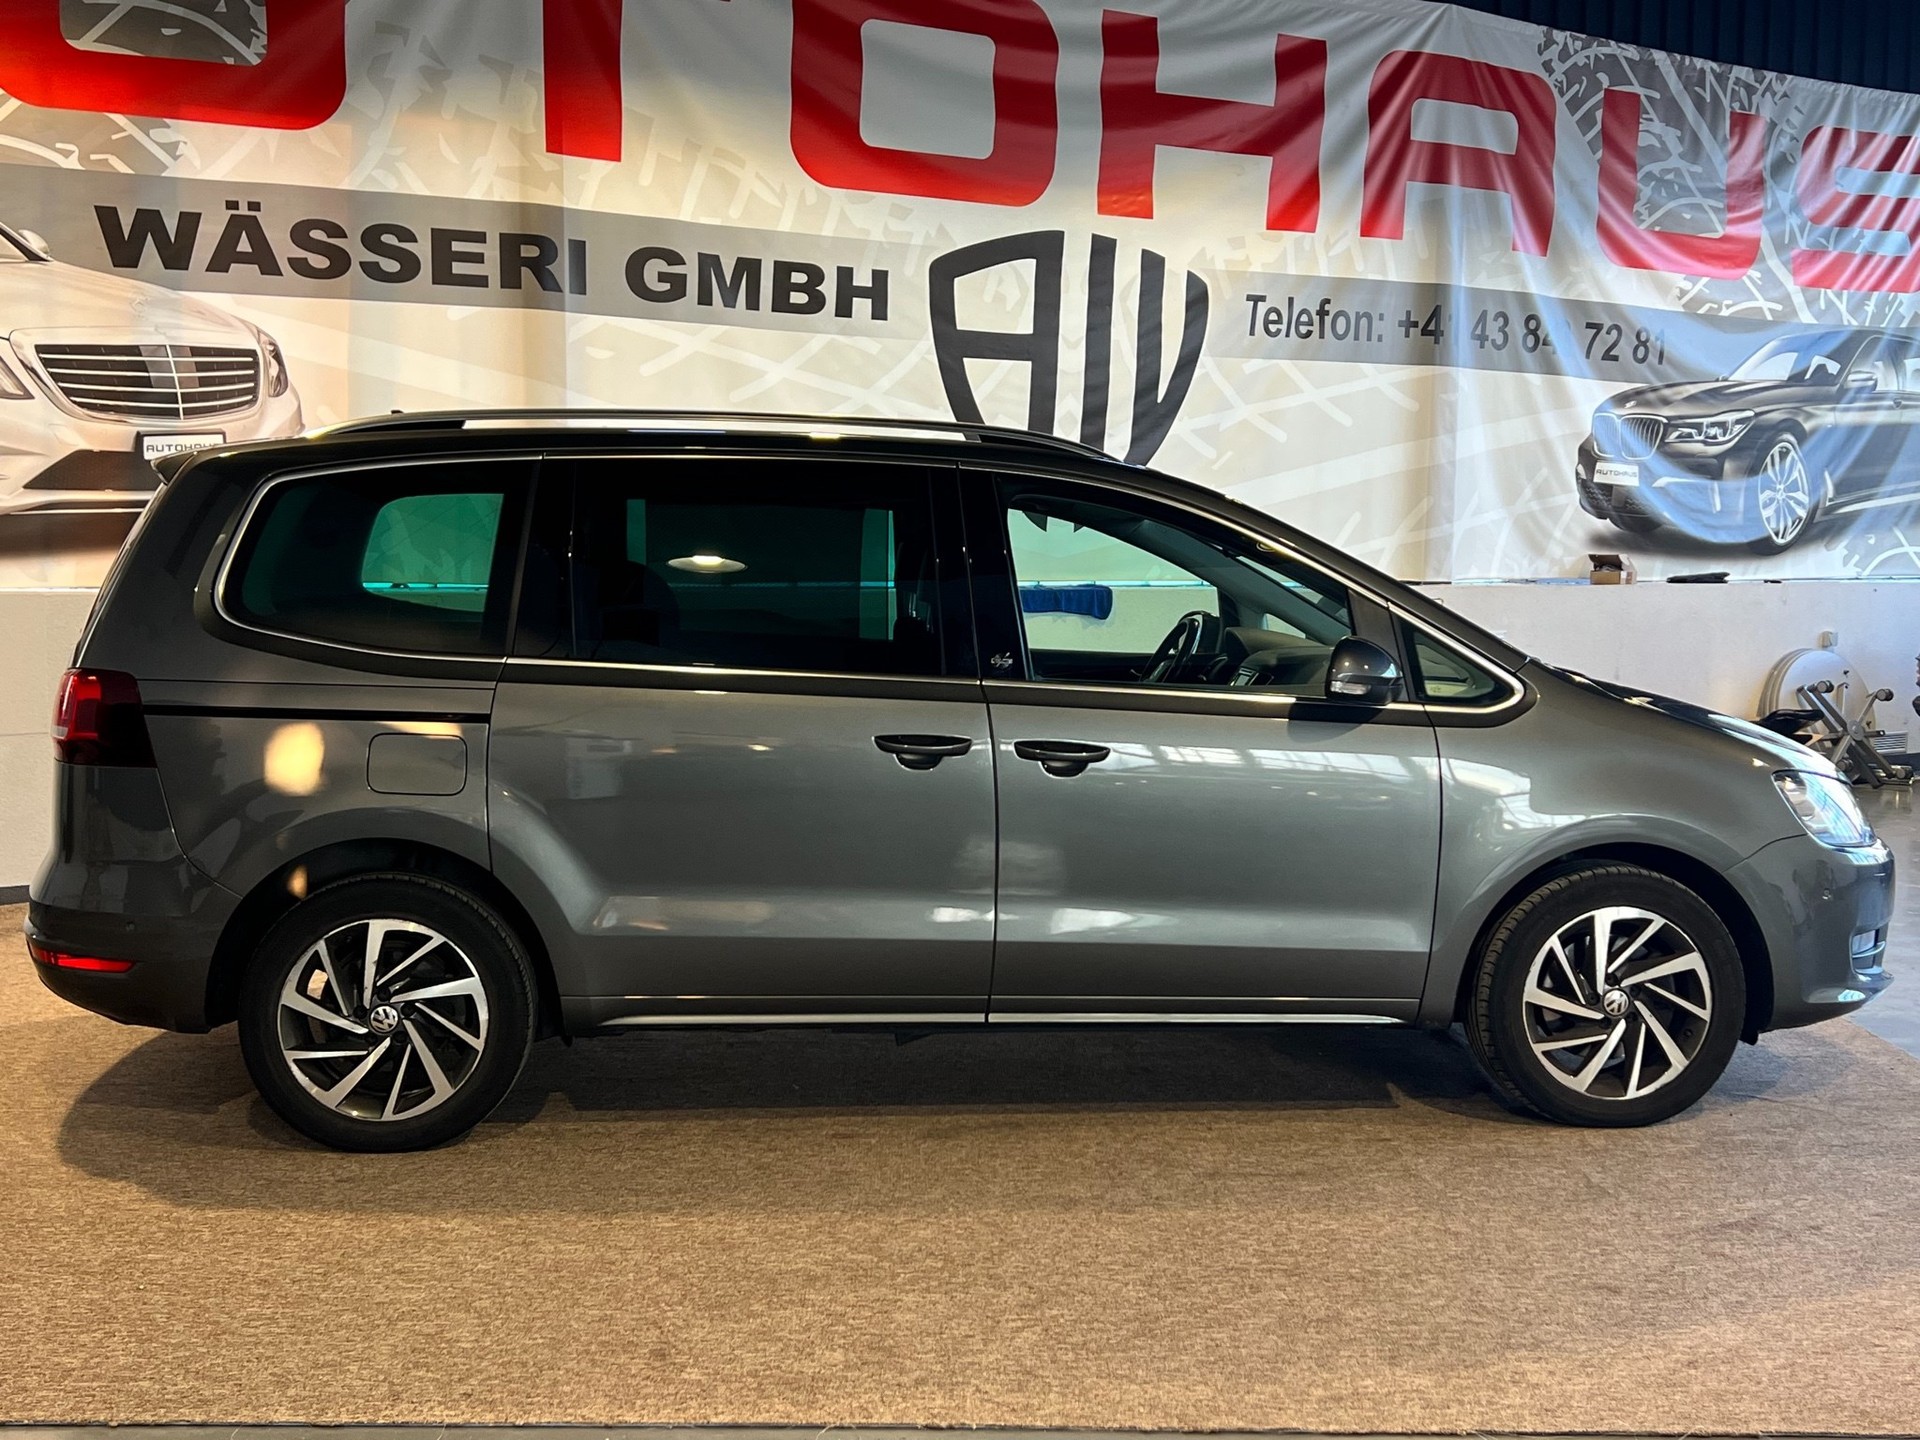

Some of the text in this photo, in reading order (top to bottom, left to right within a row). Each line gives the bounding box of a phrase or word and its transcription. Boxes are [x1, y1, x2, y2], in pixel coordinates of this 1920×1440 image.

[94, 200, 889, 321] WÄSSERI GMBH
[1246, 294, 1384, 342] Telefon:
[1398, 305, 1456, 346] +4
[1470, 309, 1509, 351] 43
[1585, 322, 1623, 362] 72
[1633, 327, 1665, 366] 81
[146, 443, 219, 453] AUTOHA
